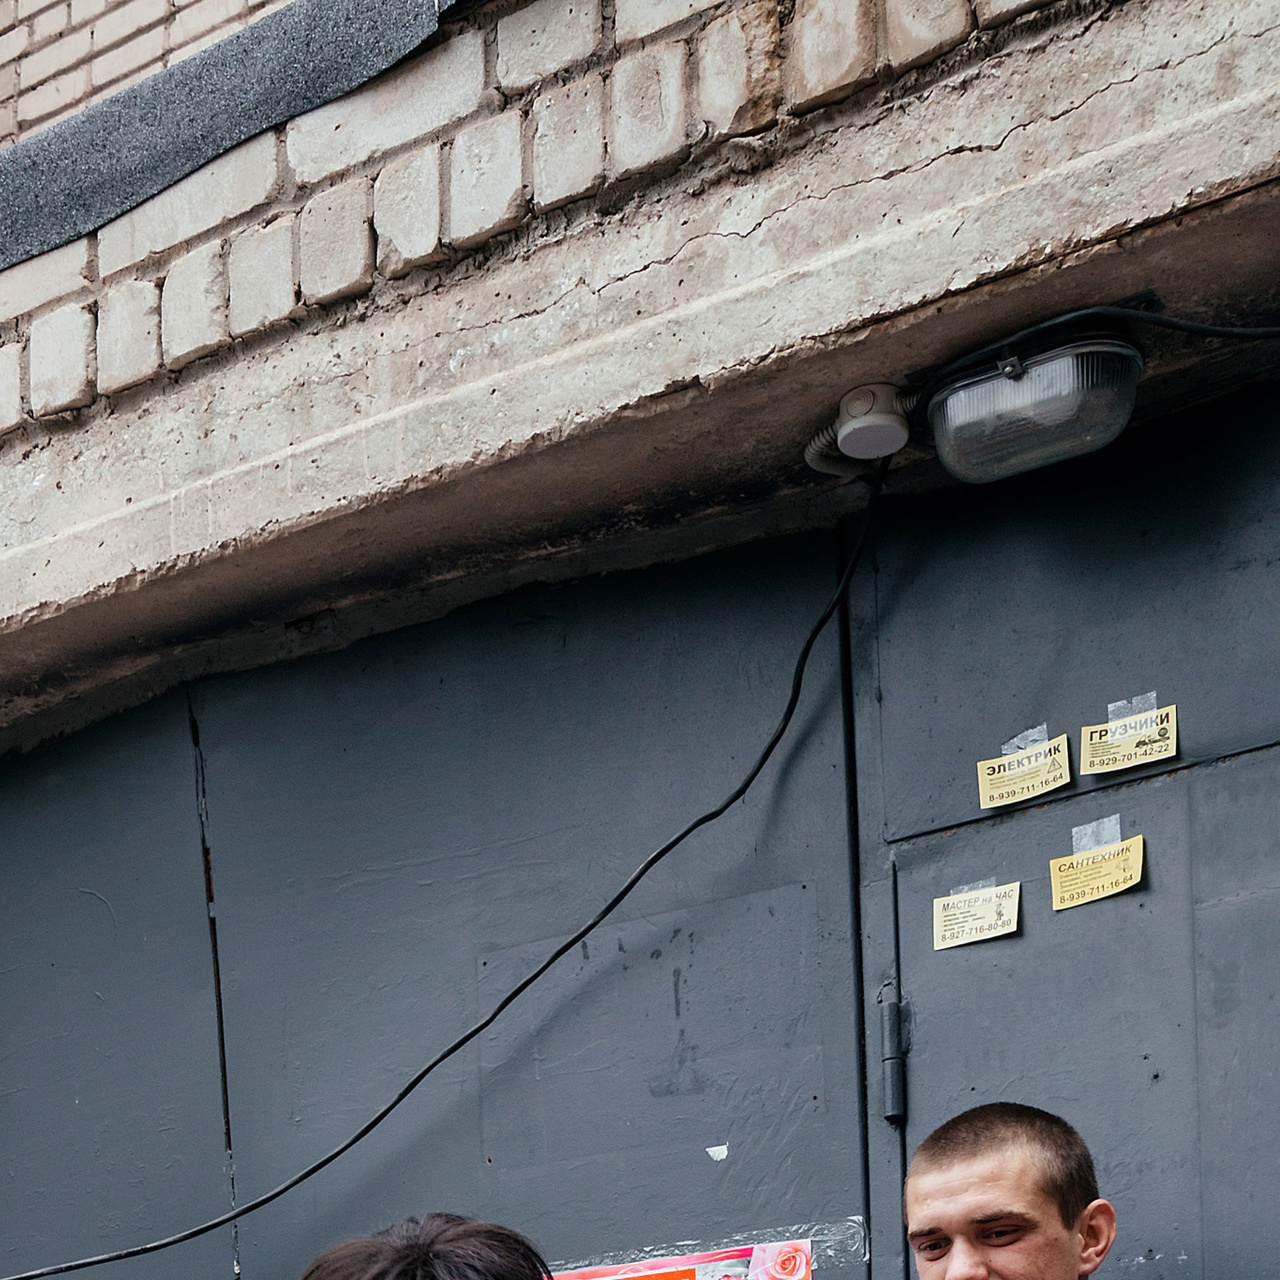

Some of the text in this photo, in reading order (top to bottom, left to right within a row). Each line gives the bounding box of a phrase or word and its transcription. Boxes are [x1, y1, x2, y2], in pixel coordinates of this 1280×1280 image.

[1089, 712, 1170, 742] ГРУЗЧИКИ
[986, 743, 1061, 776] ЭЛЕКТРИК
[1088, 744, 1169, 768] 8-929-701-42-22
[988, 773, 1063, 802] 8-939-711-16-64
[1058, 844, 1132, 873] САНТЕХНИК
[942, 896, 980, 912] МАСТЕР
[995, 889, 1014, 900] ЧАС
[1060, 873, 1133, 904] 8-939-711-16-64
[941, 919, 1012, 942] 8-927-716-80-80
